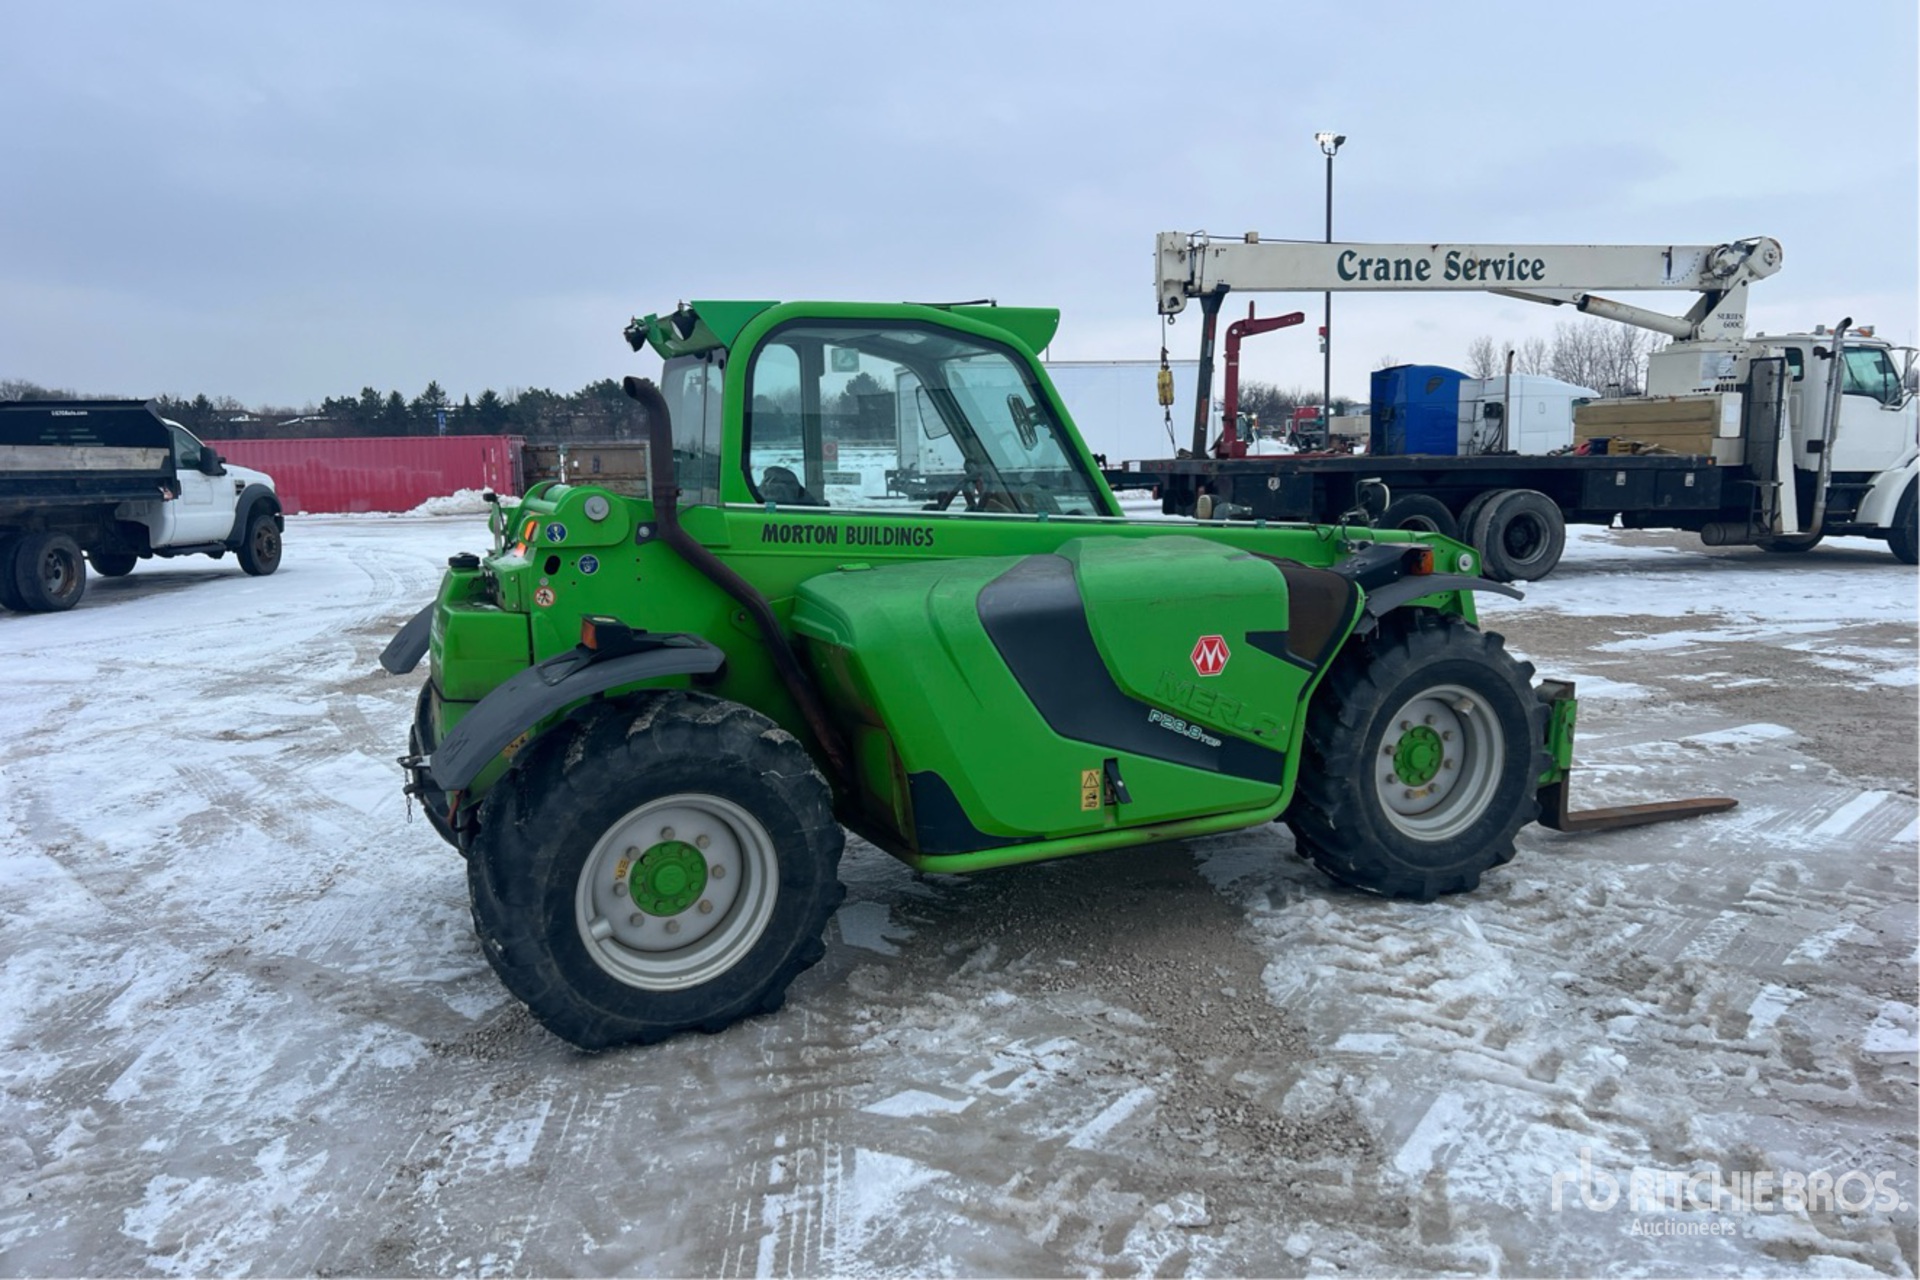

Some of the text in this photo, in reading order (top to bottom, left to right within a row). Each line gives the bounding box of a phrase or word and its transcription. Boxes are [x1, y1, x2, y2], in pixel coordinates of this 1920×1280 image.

[1337, 250, 1545, 281] Crane Service
[1717, 312, 1744, 320] SERIES
[761, 523, 934, 547] MORTON BUILDINGS
